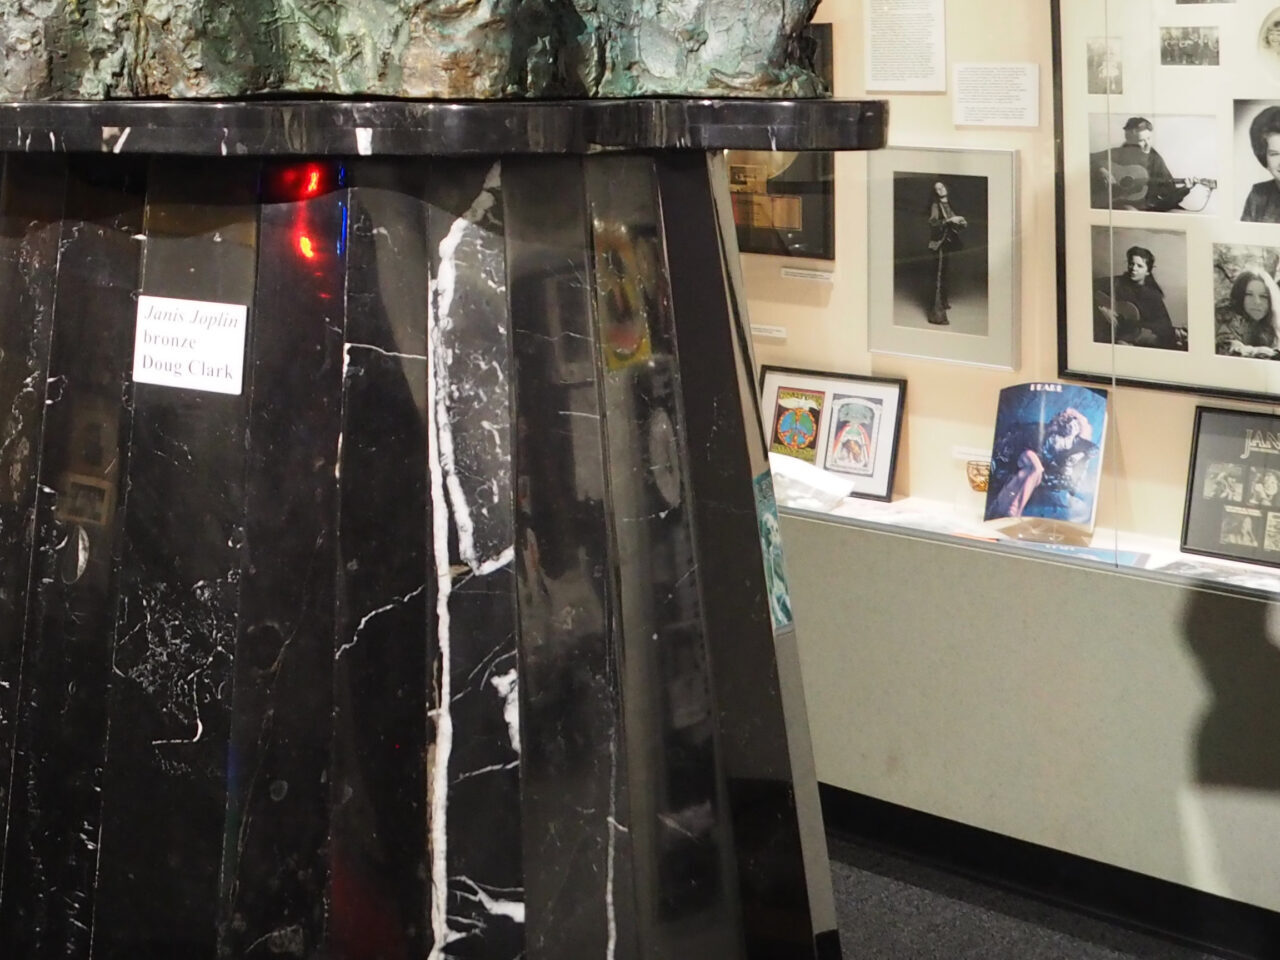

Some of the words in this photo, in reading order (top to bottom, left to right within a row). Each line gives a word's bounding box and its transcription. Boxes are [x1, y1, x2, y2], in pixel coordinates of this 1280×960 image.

[144, 305, 184, 323] Janis
[189, 309, 239, 330] Joplin
[144, 329, 196, 350] bronze
[142, 354, 182, 377] Doug
[188, 359, 233, 380] Clark
